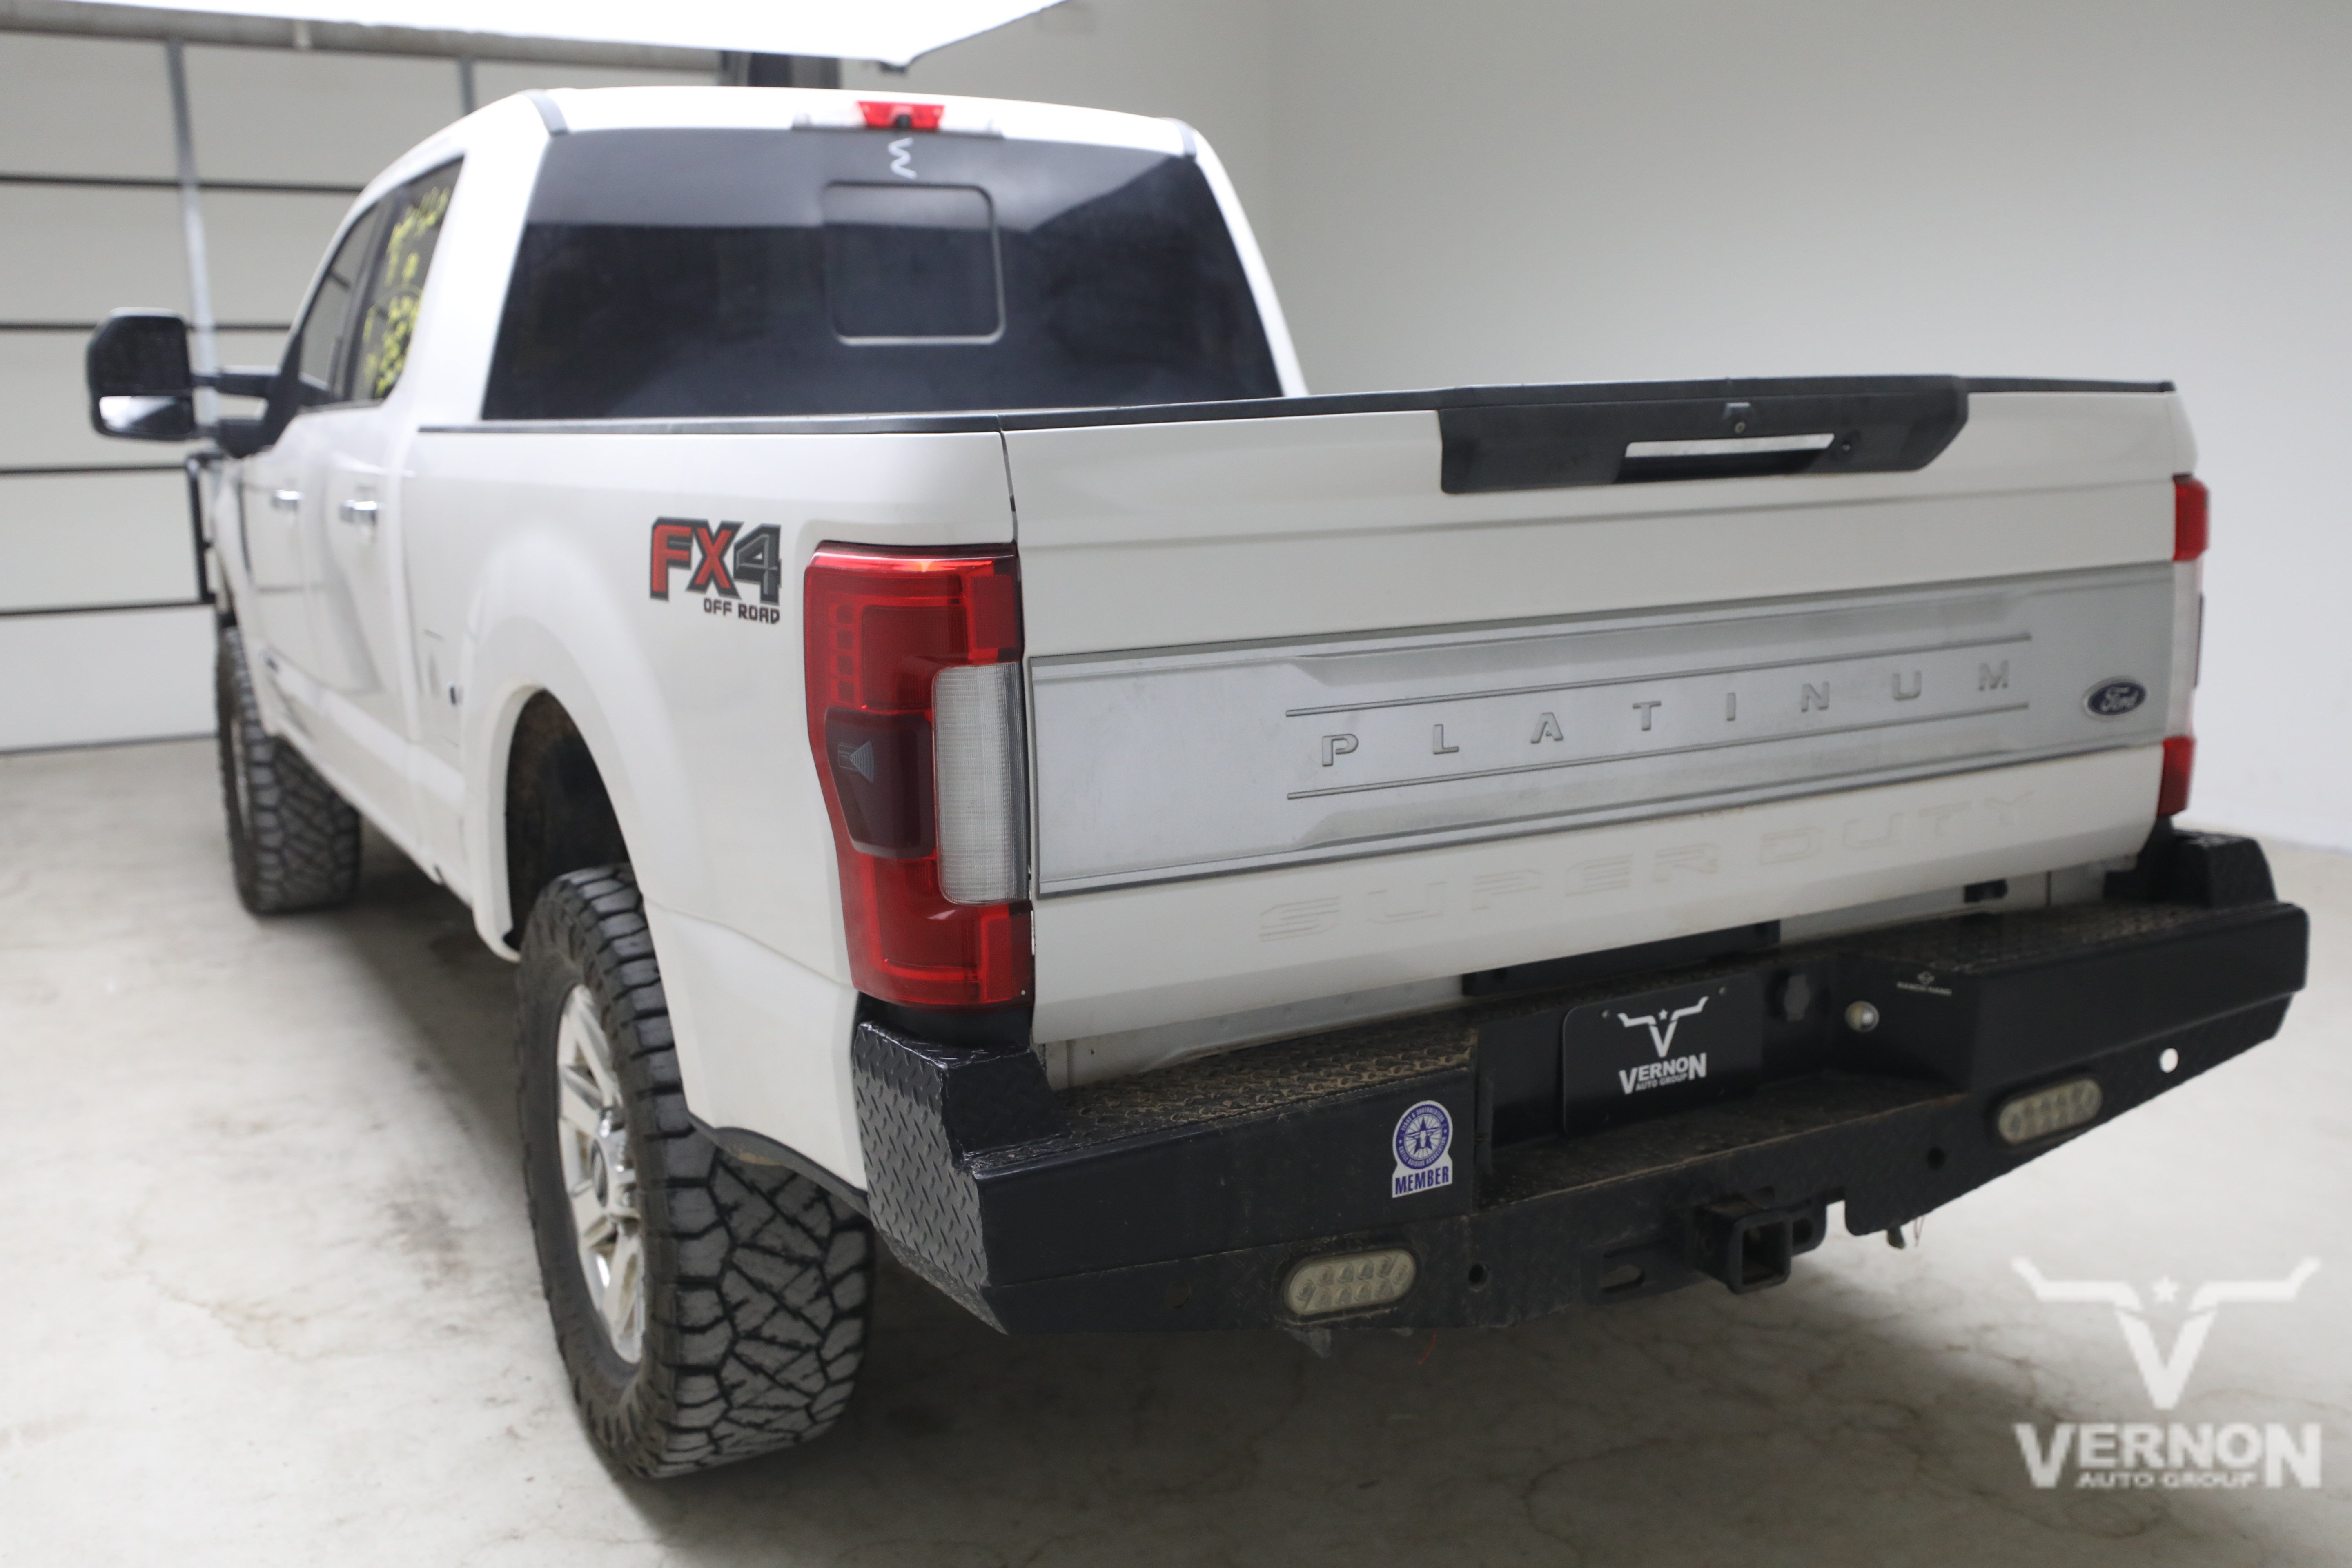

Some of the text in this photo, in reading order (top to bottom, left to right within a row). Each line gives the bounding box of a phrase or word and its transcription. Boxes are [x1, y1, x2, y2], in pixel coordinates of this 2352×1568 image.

[649, 516, 782, 607] FX4
[703, 597, 781, 625] OFF ROAD
[1321, 659, 2011, 768] PLATINUM
[2099, 686, 2140, 712] Ford
[1259, 790, 2035, 942] SUPER DUTY
[1618, 1052, 1707, 1095] VERNON
[1635, 1072, 1688, 1091] AUTO GROUP
[1395, 1166, 1449, 1195] MEMBER
